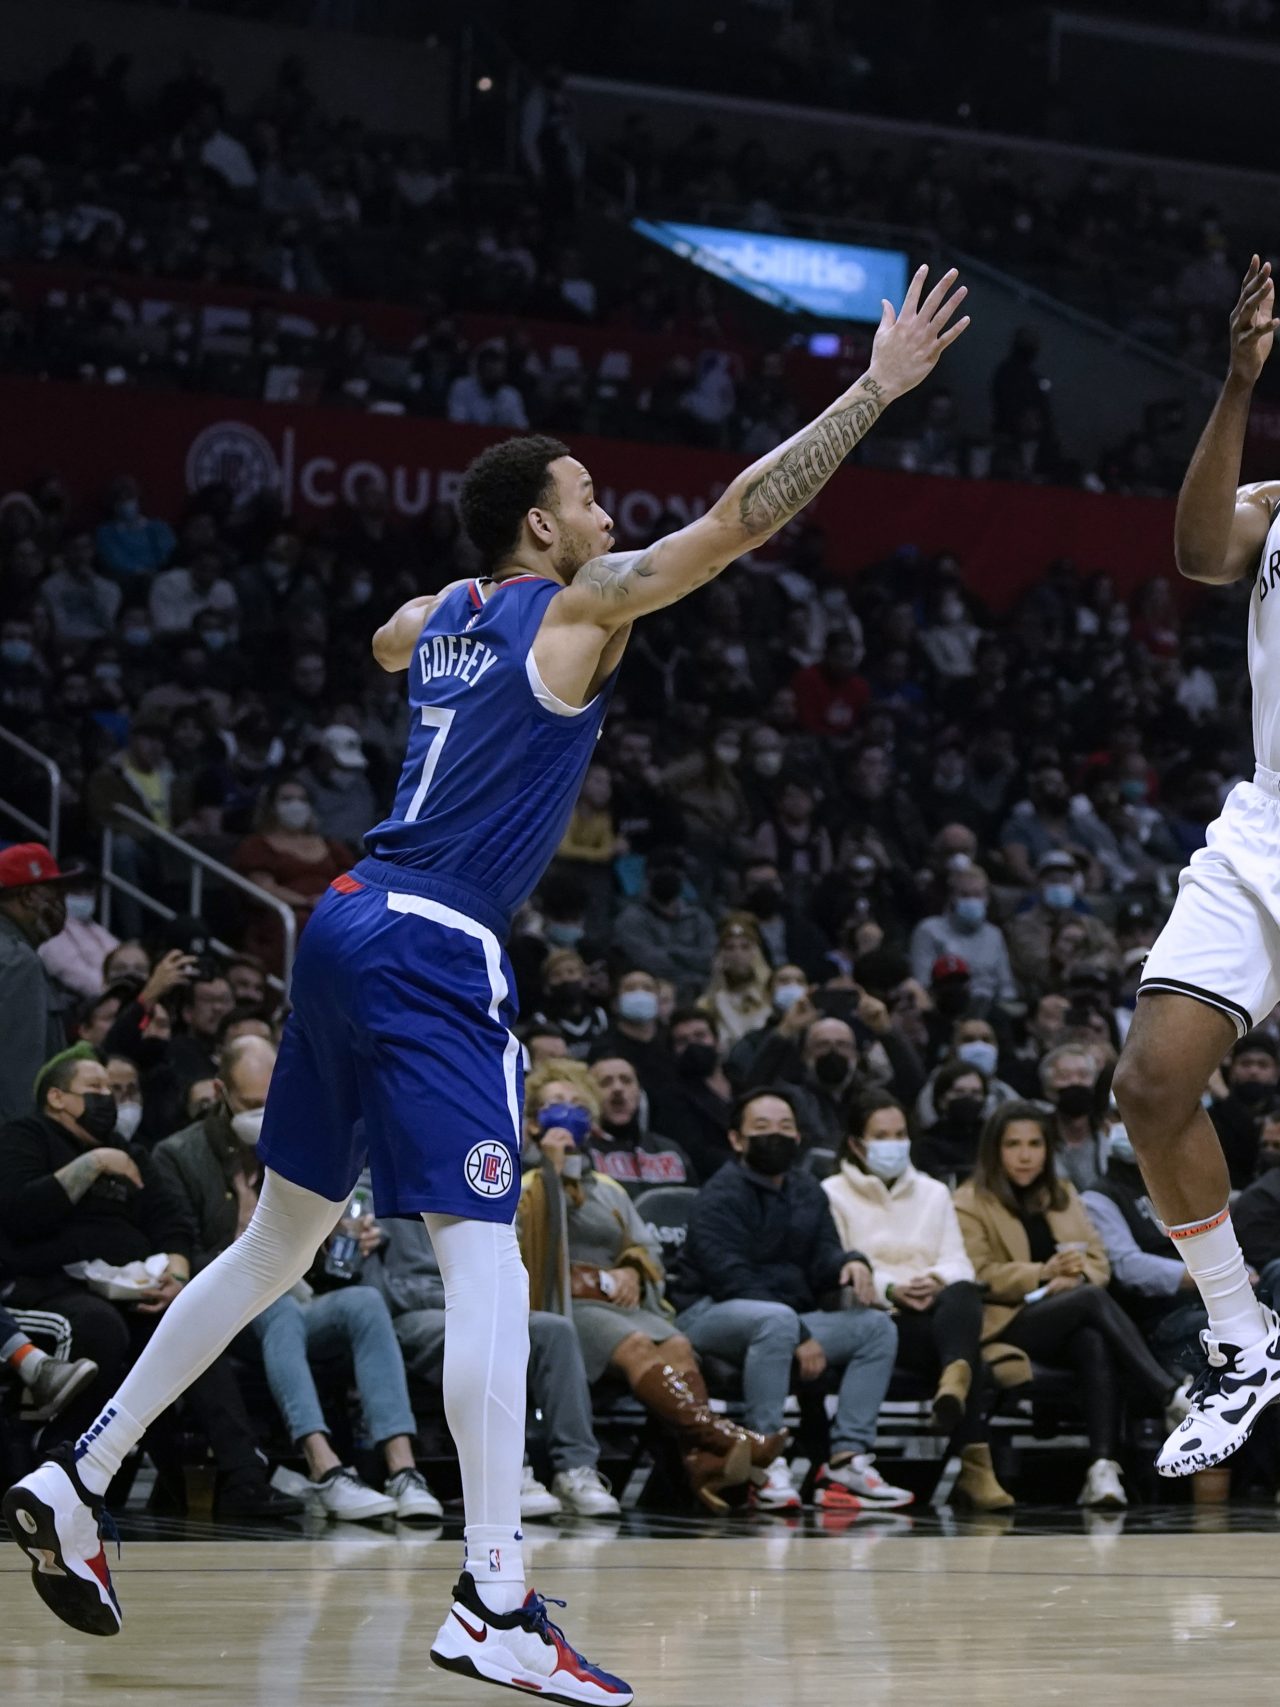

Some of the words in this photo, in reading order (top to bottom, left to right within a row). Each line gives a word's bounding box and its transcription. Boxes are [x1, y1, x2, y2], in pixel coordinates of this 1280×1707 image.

[300, 456, 467, 519] COUR
[418, 635, 499, 688] COFFEY
[403, 704, 457, 823] 7
